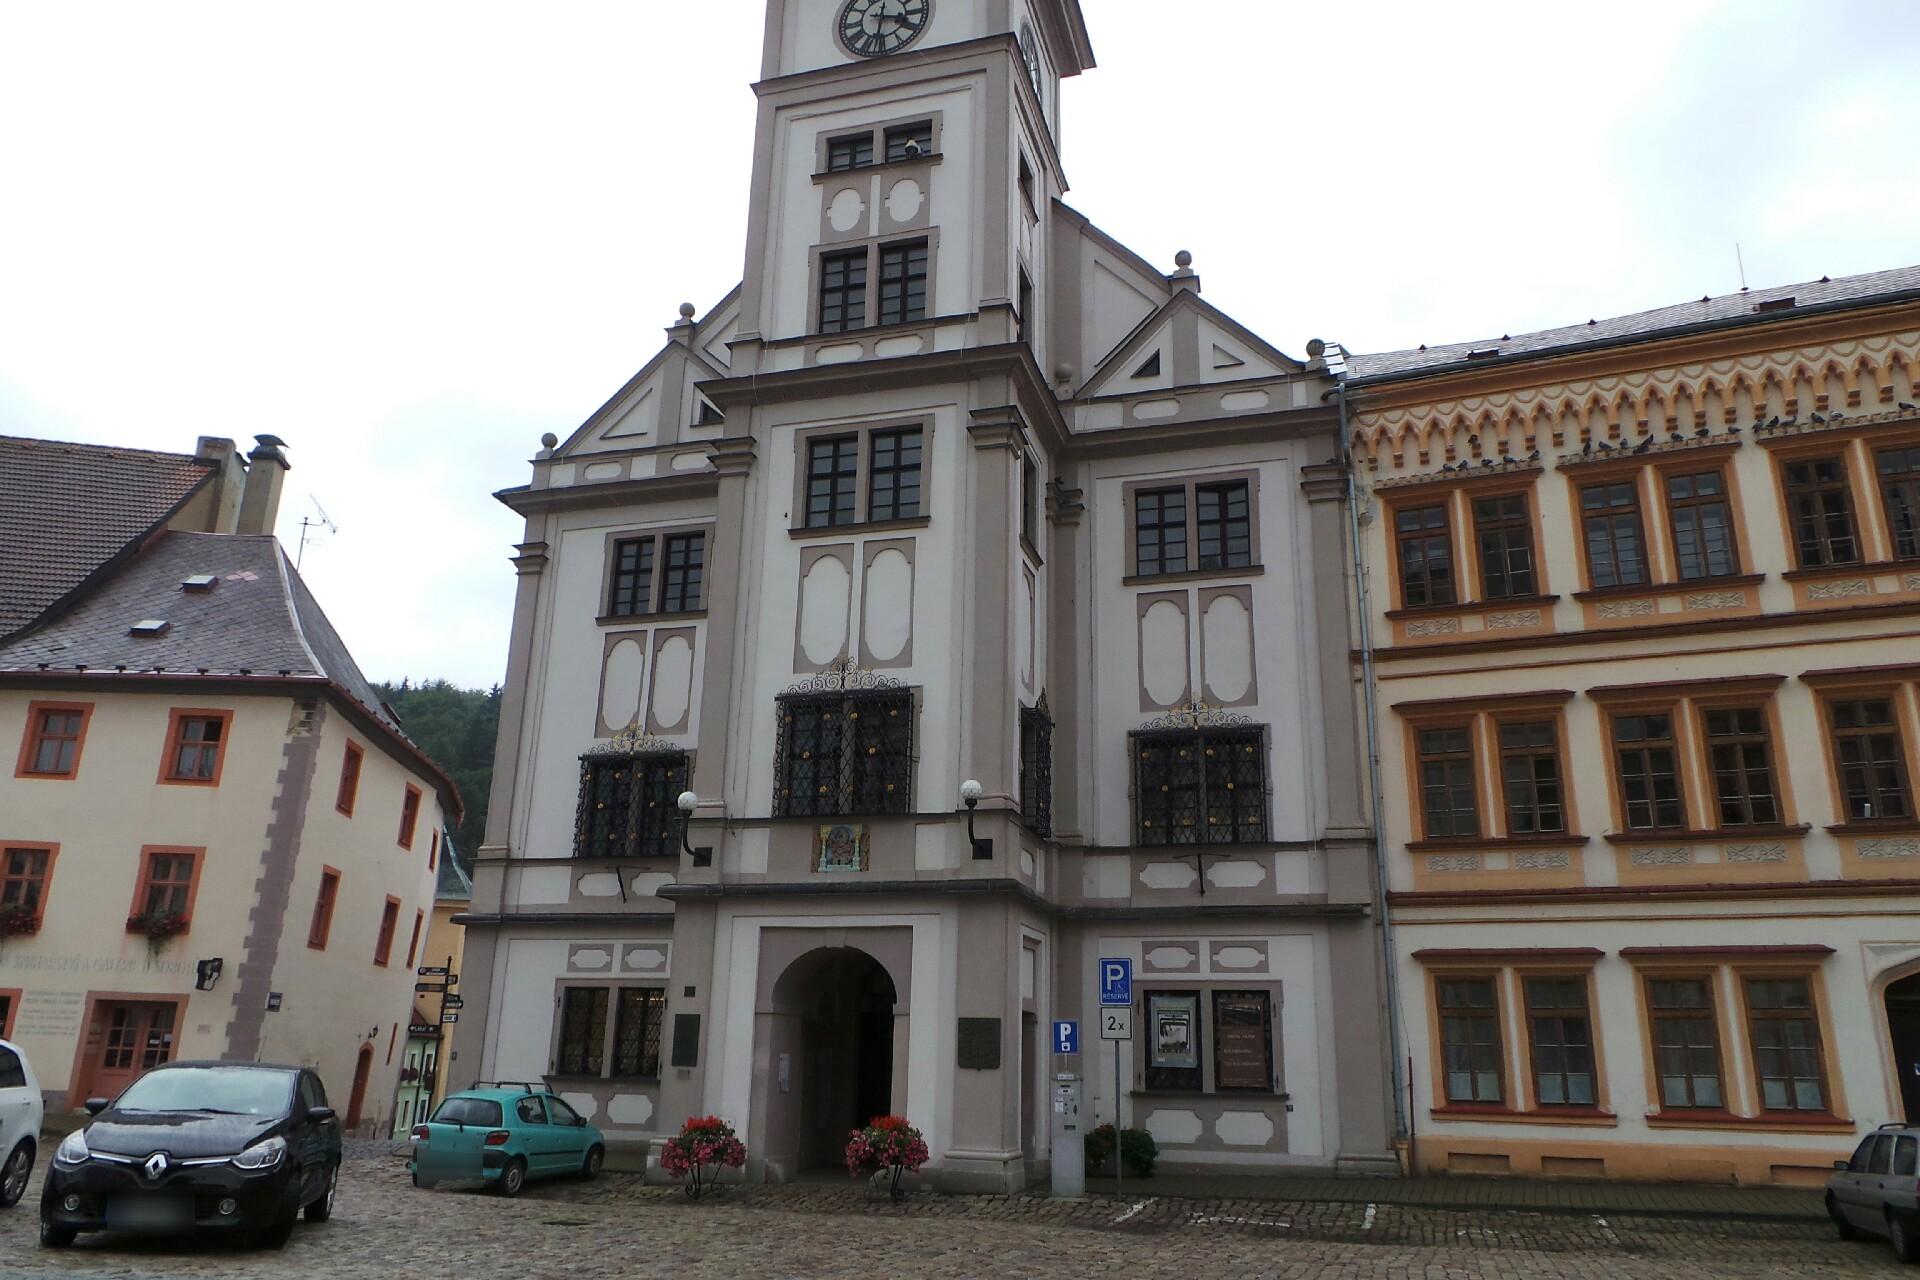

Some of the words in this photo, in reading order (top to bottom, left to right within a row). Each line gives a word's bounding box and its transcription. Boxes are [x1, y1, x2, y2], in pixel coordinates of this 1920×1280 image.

[1106, 964, 1125, 991] P
[1060, 1023, 1072, 1042] P
[1107, 1016, 1125, 1031] 2x
